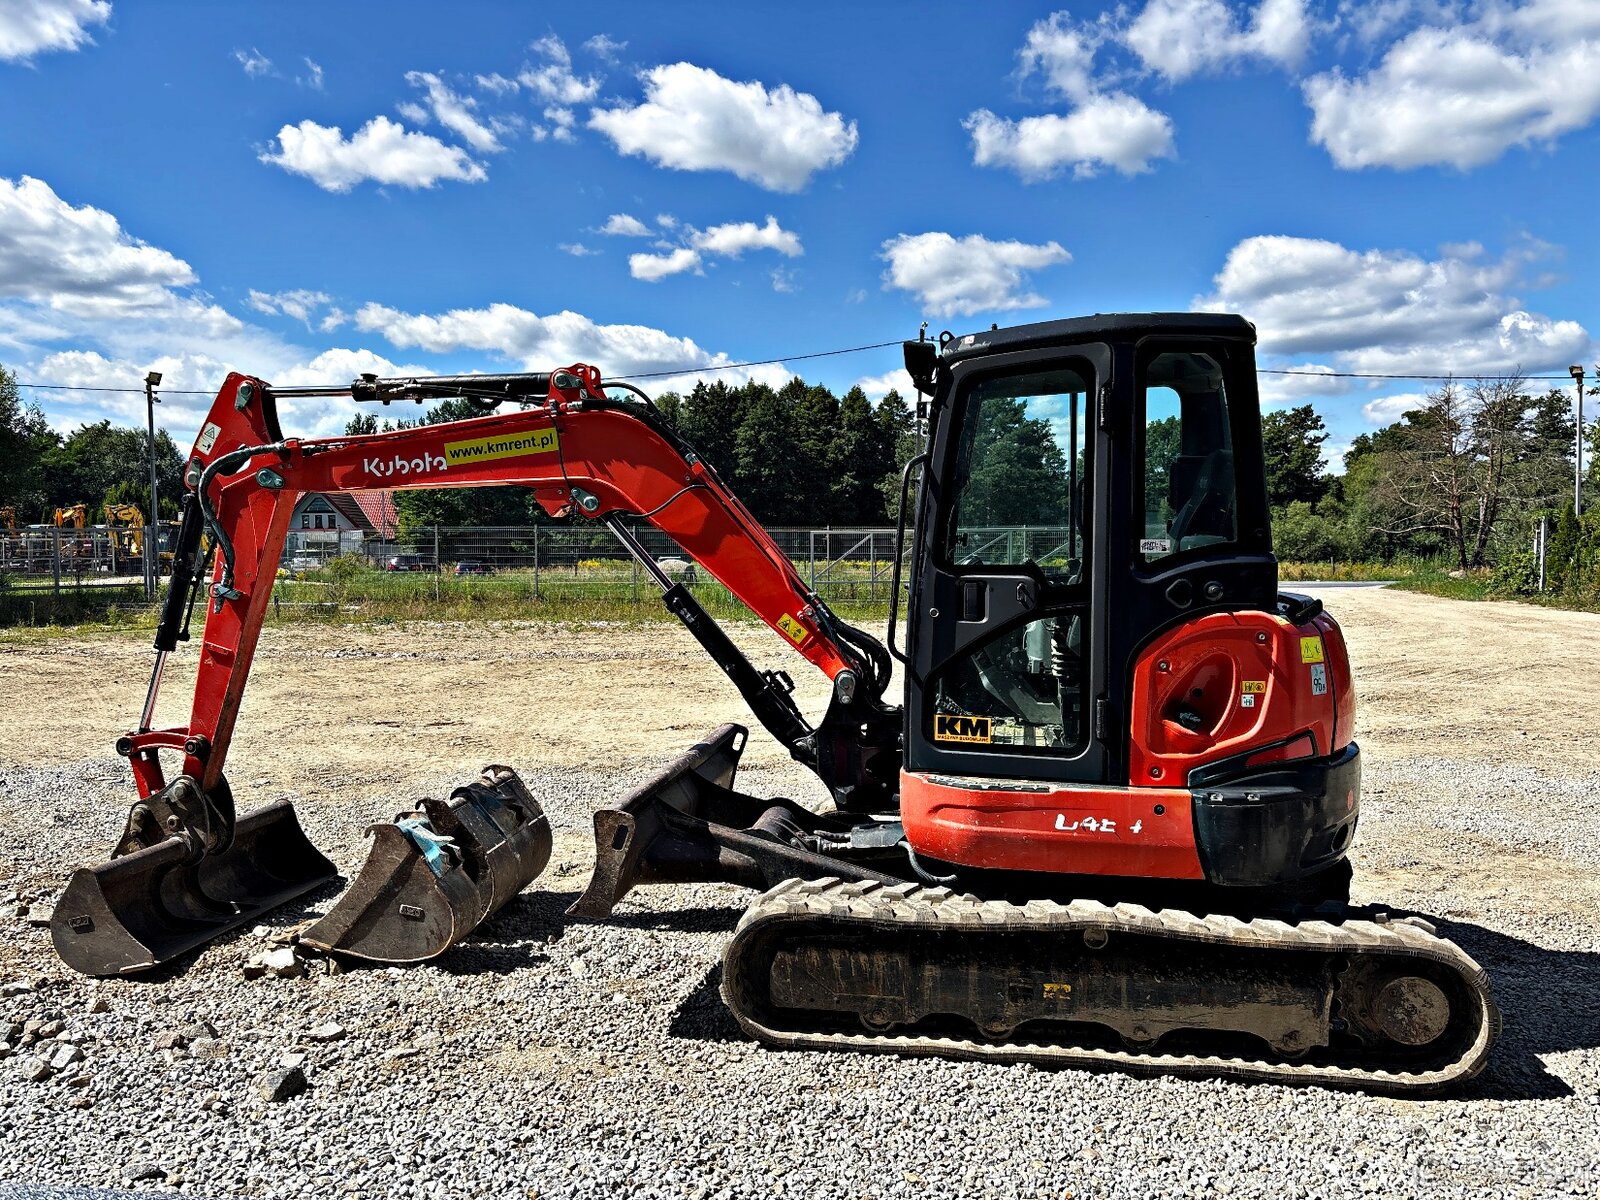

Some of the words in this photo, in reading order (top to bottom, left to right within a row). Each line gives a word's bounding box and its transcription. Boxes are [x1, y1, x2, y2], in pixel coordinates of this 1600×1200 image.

[449, 433, 554, 459] www.kmrent.pl
[363, 452, 448, 477] Kubota
[937, 716, 989, 737] KM
